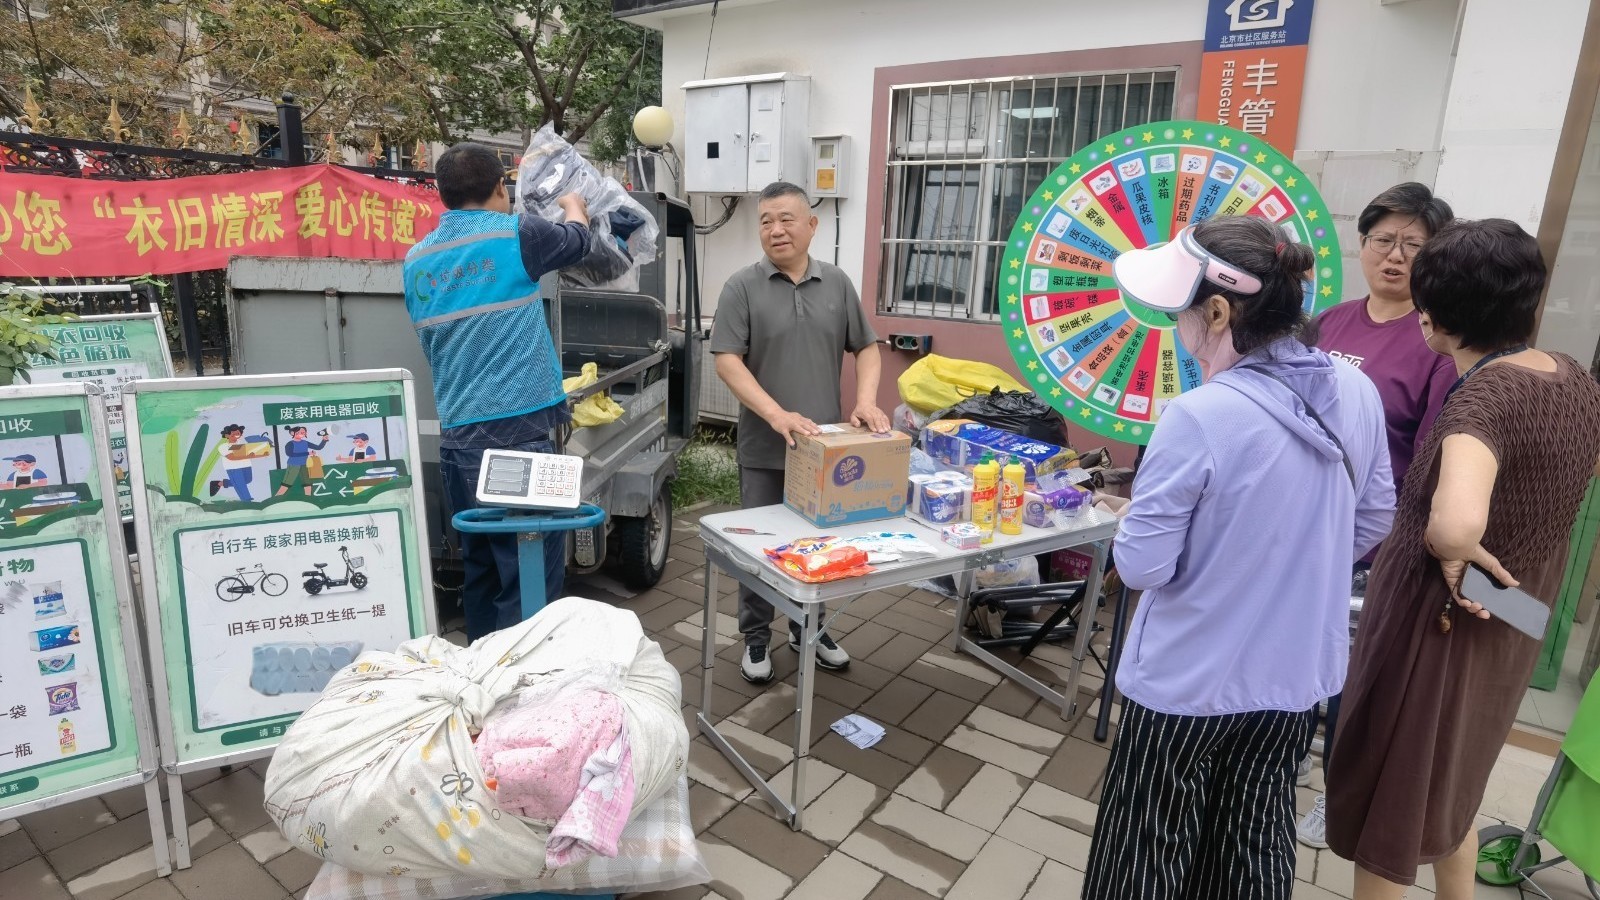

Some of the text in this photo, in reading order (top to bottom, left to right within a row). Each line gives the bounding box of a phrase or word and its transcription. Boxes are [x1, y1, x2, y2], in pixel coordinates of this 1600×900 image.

[1220, 29, 1287, 44] 北京市社区服务站
[1238, 58, 1279, 135] 丰管
[1157, 176, 1170, 200] 冰箱
[1175, 177, 1196, 223] 过期药品
[1107, 192, 1126, 214] 金属
[1131, 181, 1154, 226] 瓜果皮核
[0, 189, 73, 256] 您
[1085, 206, 1106, 228] 烟蒂
[440, 257, 496, 283] 垃圾分类
[1057, 250, 1103, 272] 剩饭剩菜
[1053, 275, 1099, 287] 塑料瓶罐
[1059, 312, 1094, 334] 坚果壳
[1072, 321, 1113, 353] 金属厨具
[1162, 349, 1175, 395] 玻璃容器
[279, 402, 380, 420] 废家用电器回收
[210, 524, 380, 556] 自行车 废家用电器换新物
[227, 603, 387, 637] 旧车可兑换卫生纸一提
[0, 704, 28, 720] 一袋
[0, 742, 34, 759] 一瓶
